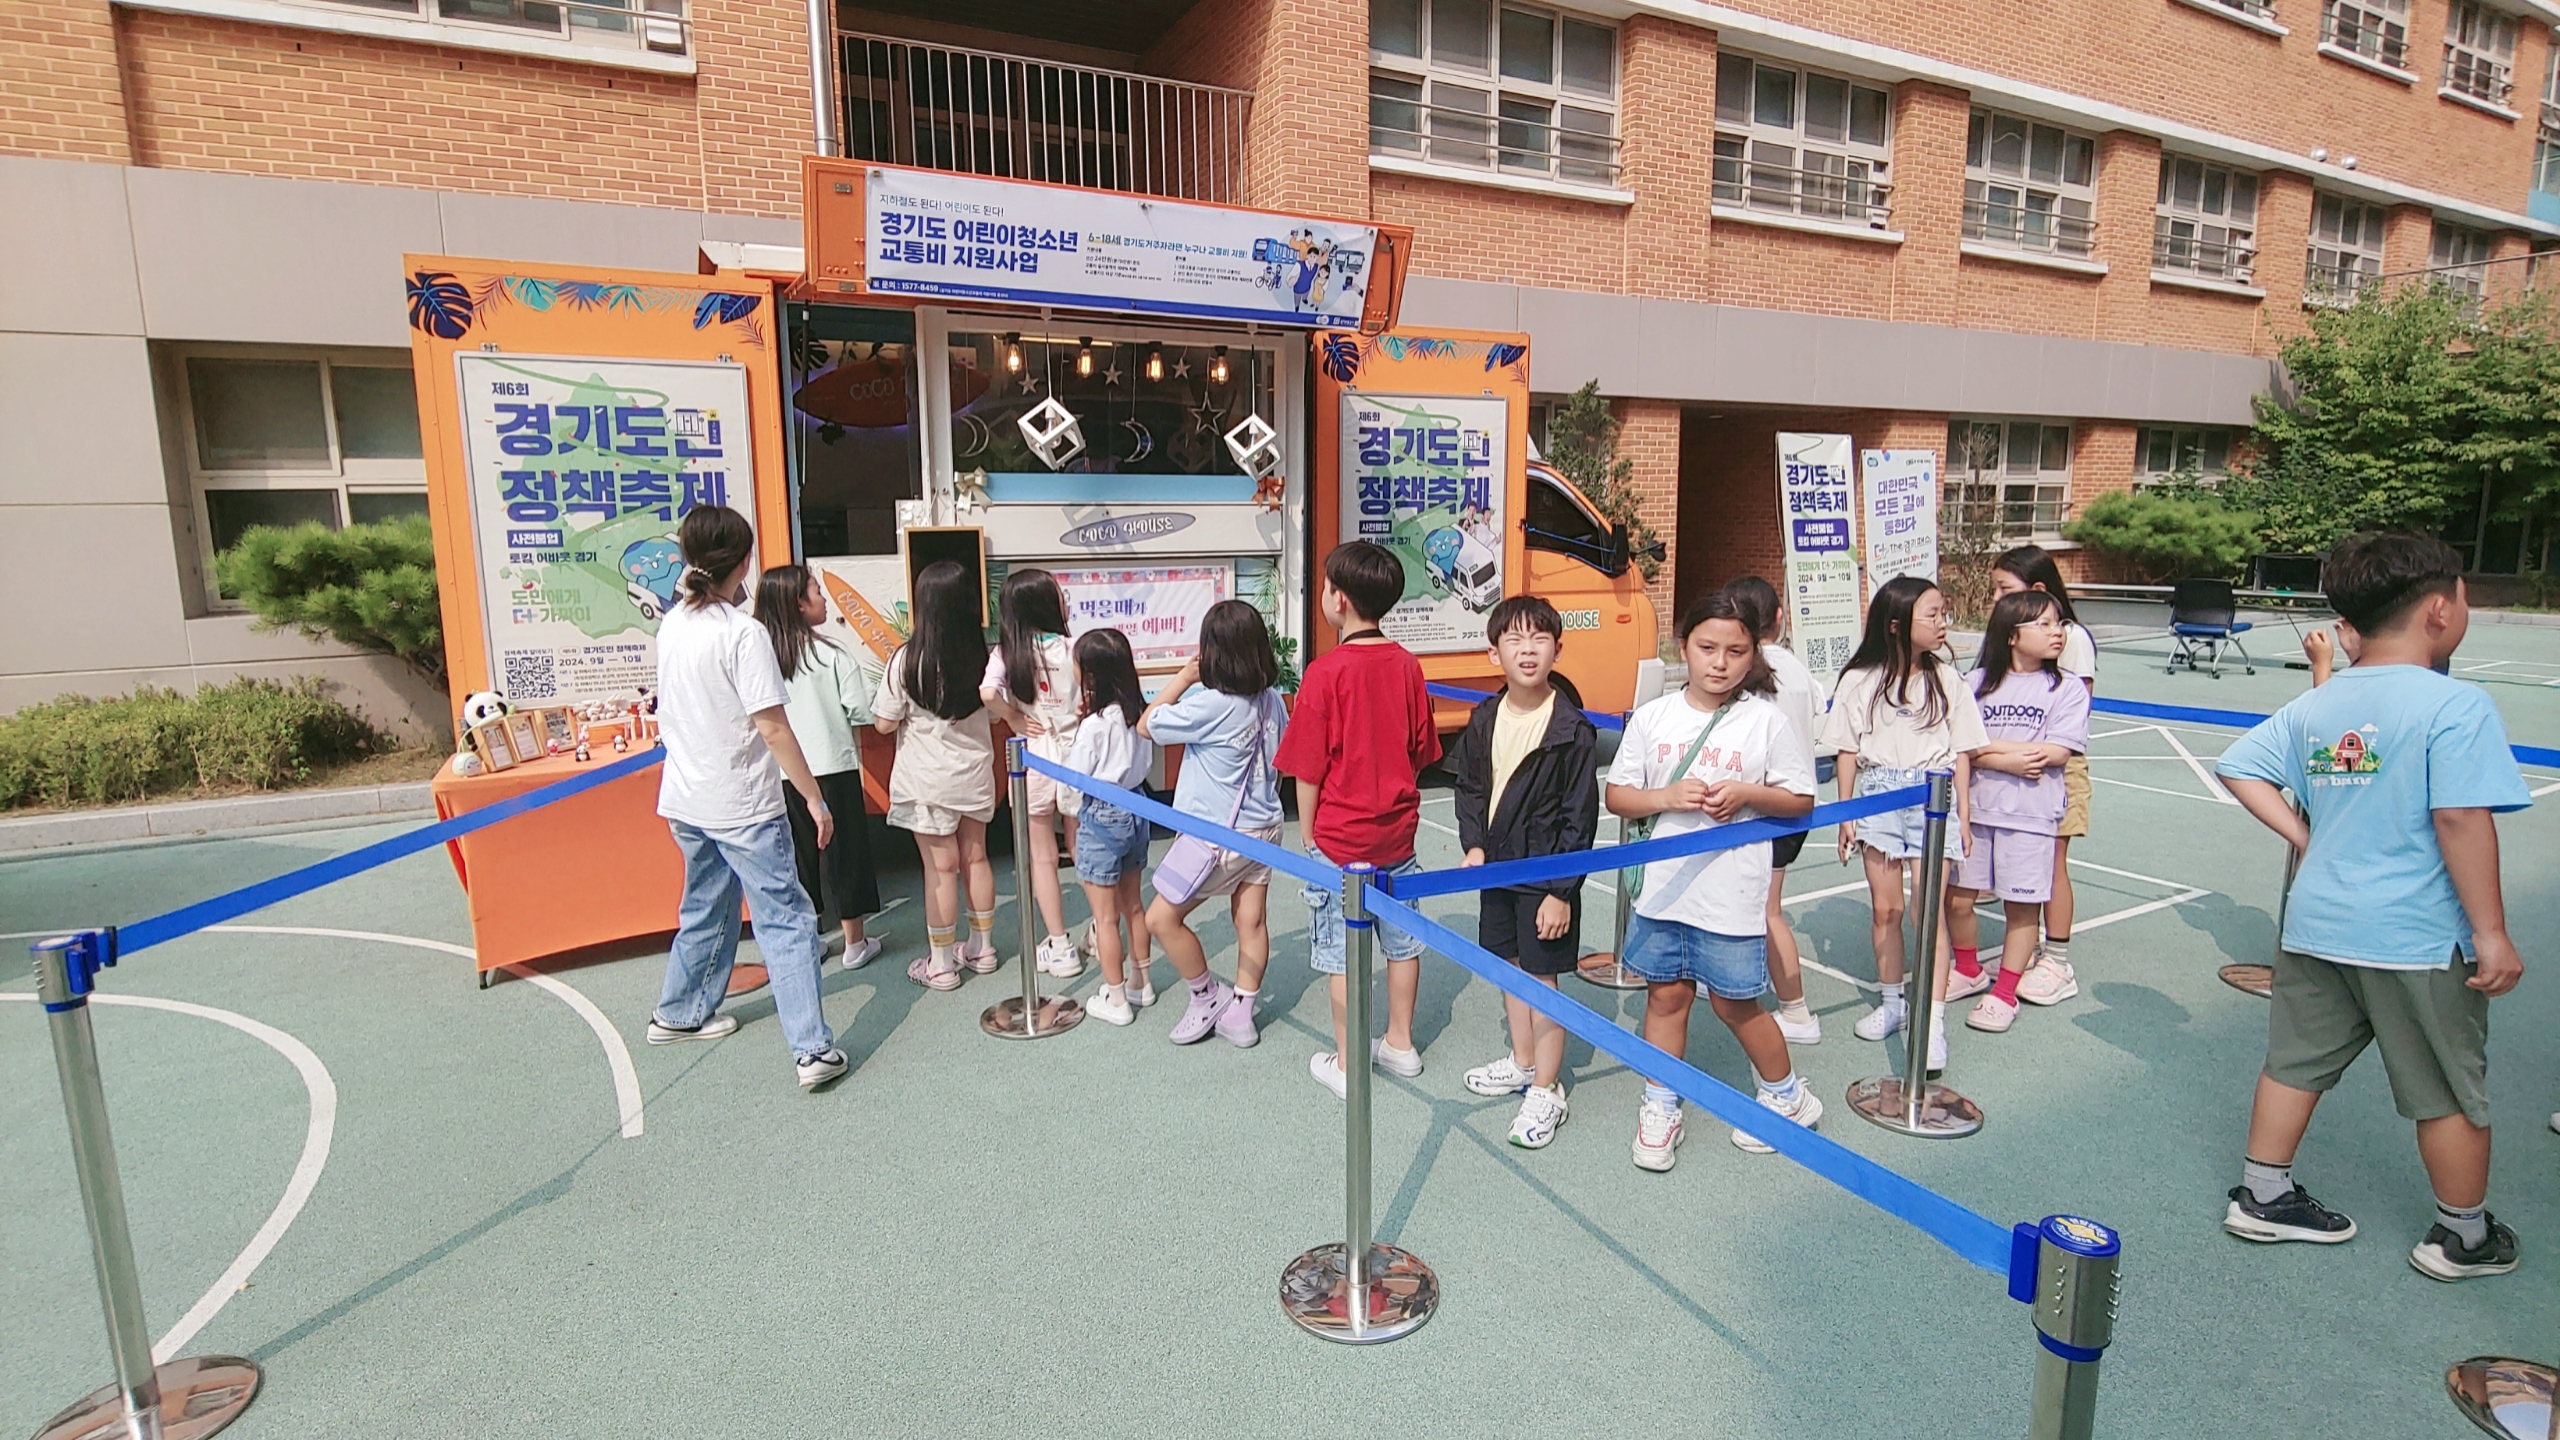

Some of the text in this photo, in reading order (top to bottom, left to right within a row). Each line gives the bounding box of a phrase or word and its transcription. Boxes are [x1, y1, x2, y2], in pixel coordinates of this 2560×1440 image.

[879, 194, 1004, 217] 지하철도 된다! 어린이도 된다!
[880, 211, 1079, 252] 경기도 어린이청소년
[1088, 232, 1122, 246] 6-18세
[1123, 237, 1183, 251] 경기도거주자라면
[1184, 244, 1206, 255] 누구나
[1231, 249, 1248, 258] 지원!
[879, 238, 1038, 273] 교통비 지원사업
[882, 280, 896, 290] 문의
[902, 282, 939, 293] 1577-8459
[491, 382, 530, 396] 제6회
[1358, 411, 1380, 422] 제6회
[494, 402, 724, 457] 경기도민
[1358, 427, 1490, 467] 경기도민
[1785, 464, 1847, 486] 경기도민
[1878, 475, 1918, 495] 대한민국
[501, 469, 727, 522] 정책축제
[1358, 476, 1490, 515] 정책축제
[1789, 490, 1848, 513] 정책축제
[1875, 494, 1925, 517] 모든 길에
[1077, 516, 1175, 544] COCO HOUSE
[1884, 516, 1917, 536] 통한다
[536, 552, 571, 563] 어바웃
[574, 551, 597, 562] 경기
[1798, 574, 1816, 583] 2024.
[512, 589, 581, 605] 도민에게
[539, 607, 591, 623] 가까이
[1142, 616, 1185, 635] 예뻐!
[583, 645, 614, 654] 경기도민
[559, 658, 588, 667] 2024.
[590, 656, 605, 665] 9월
[622, 655, 642, 663] 10월
[1984, 705, 2044, 725] OUTDOOR
